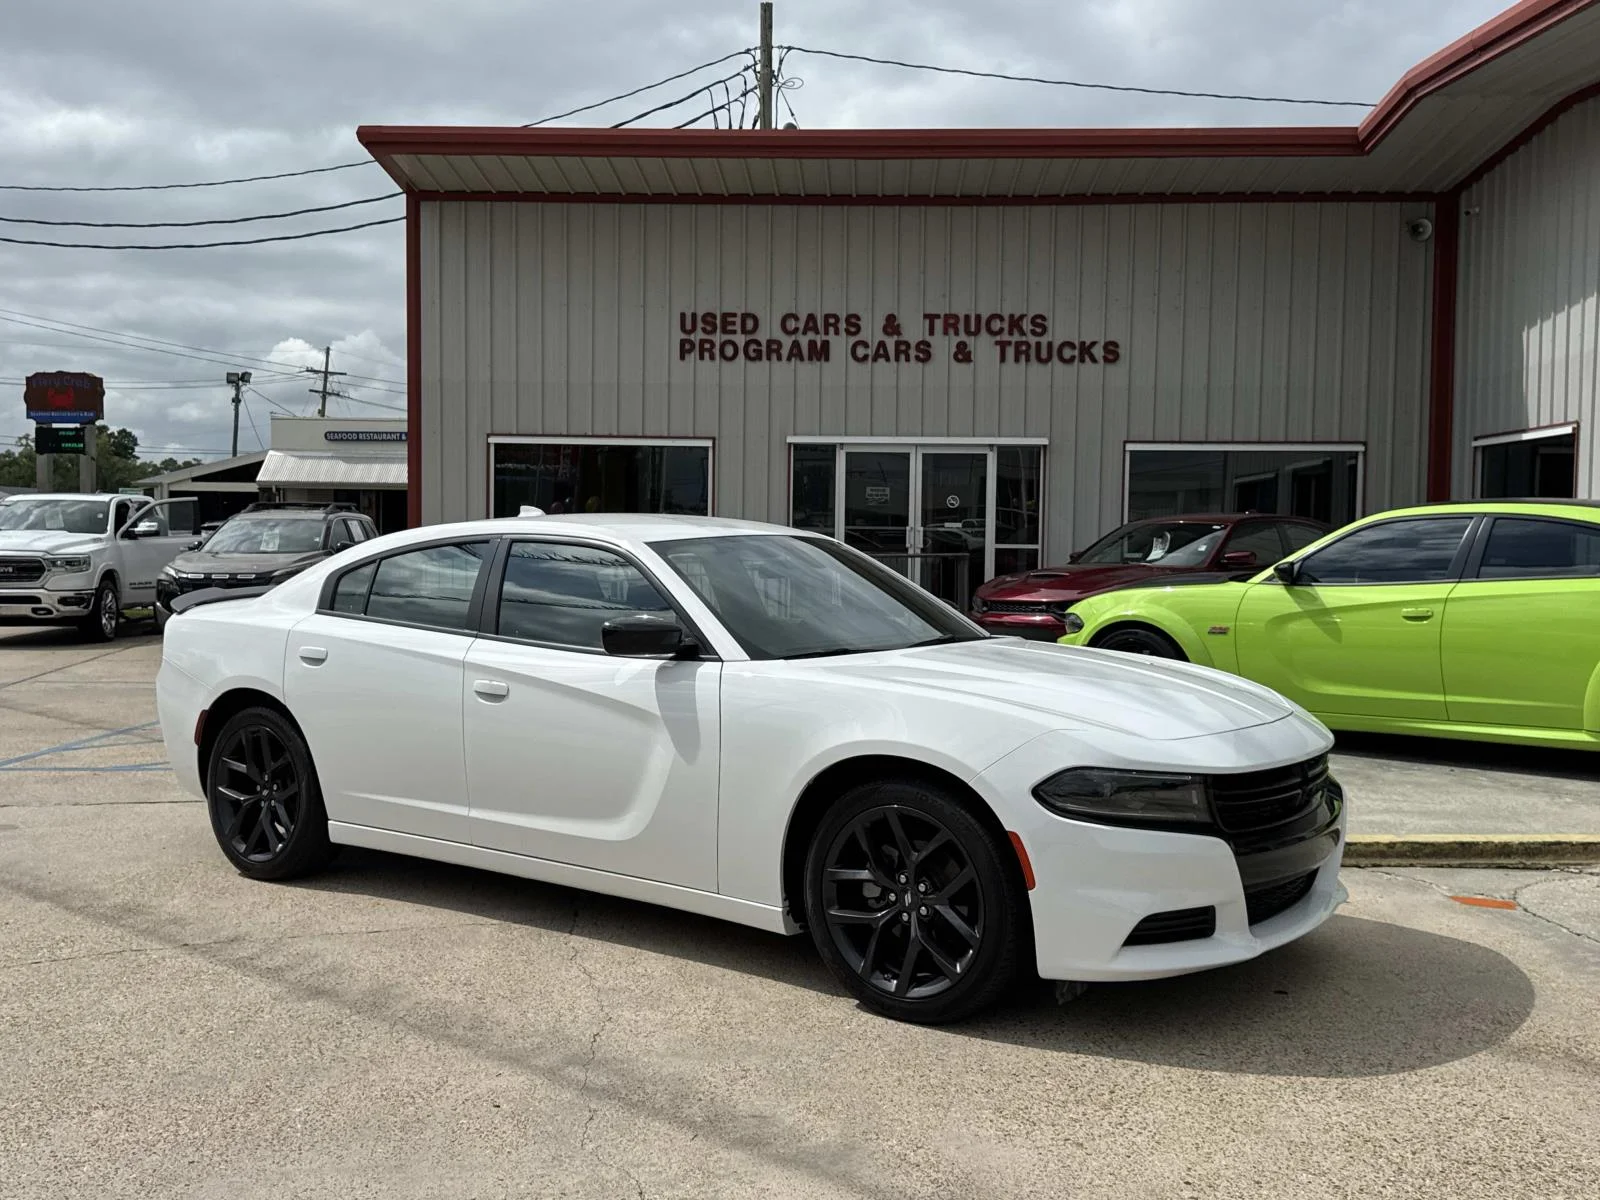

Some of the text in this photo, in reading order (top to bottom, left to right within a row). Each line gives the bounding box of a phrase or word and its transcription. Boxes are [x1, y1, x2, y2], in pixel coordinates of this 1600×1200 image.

[680, 312, 1047, 337] USED CARS & TRUCKS
[679, 338, 1120, 364] PROGRAM CARS & TRUCKS
